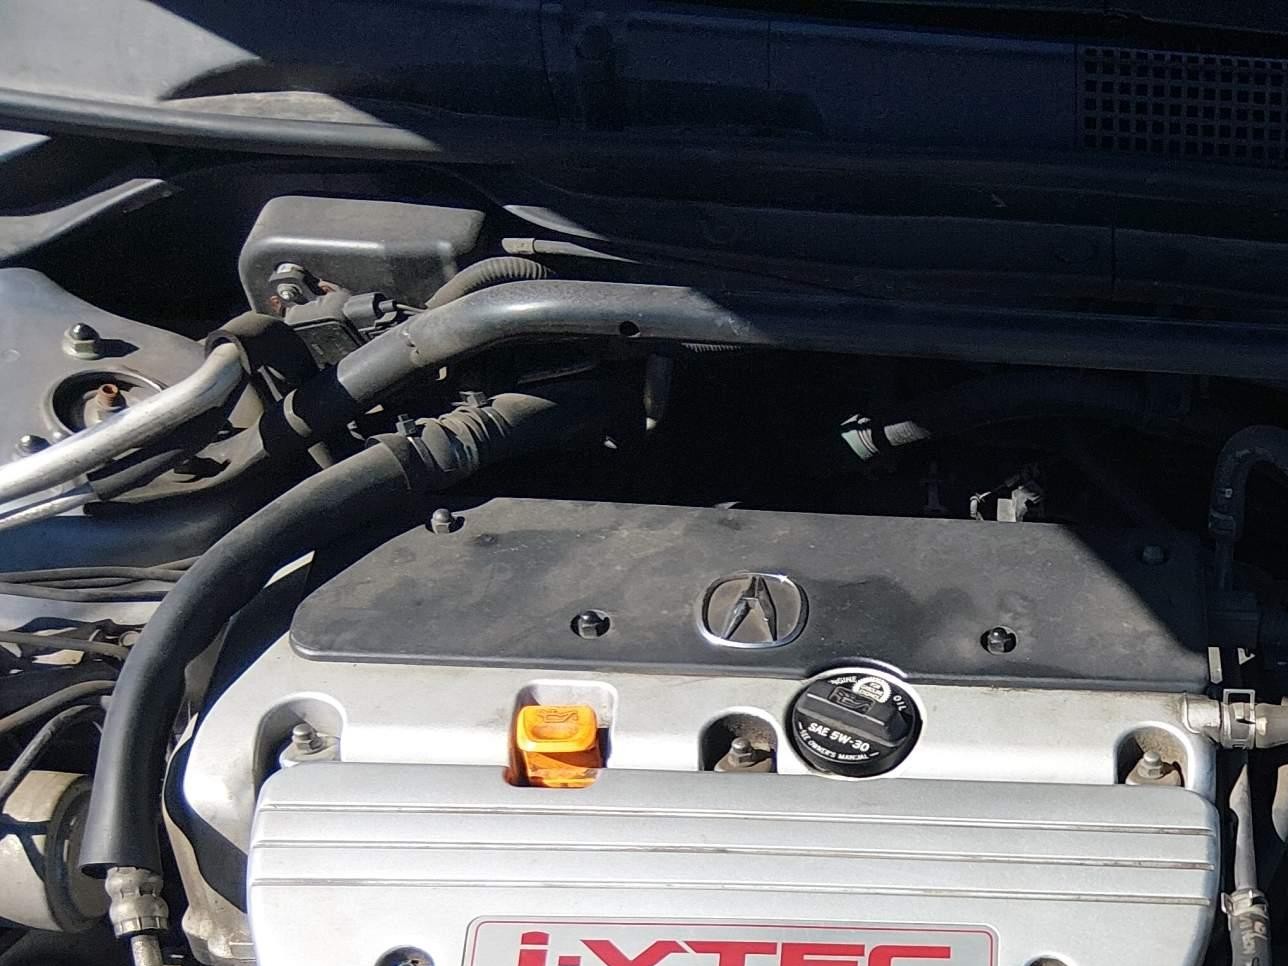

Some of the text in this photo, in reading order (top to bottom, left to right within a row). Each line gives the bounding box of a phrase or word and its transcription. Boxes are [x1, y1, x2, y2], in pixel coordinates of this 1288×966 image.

[892, 694, 908, 712] OIL
[807, 722, 871, 752] SAE 5W-30
